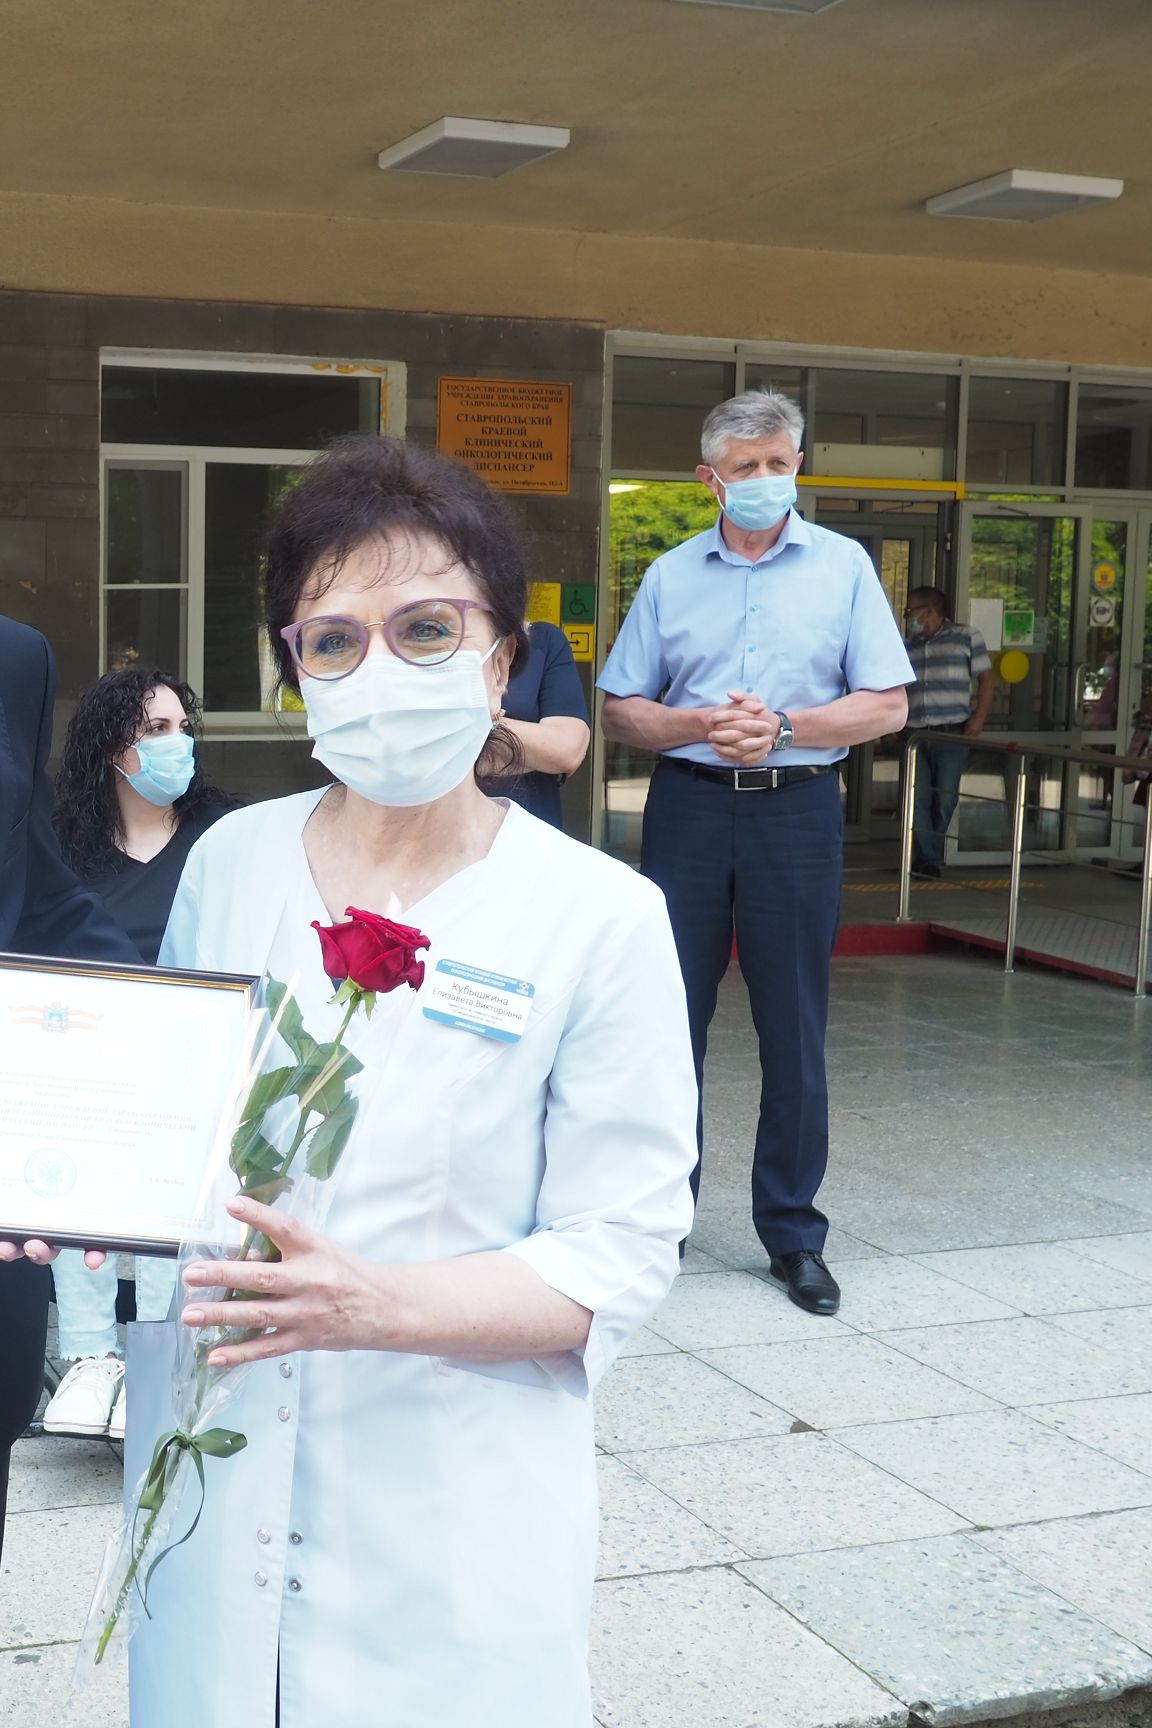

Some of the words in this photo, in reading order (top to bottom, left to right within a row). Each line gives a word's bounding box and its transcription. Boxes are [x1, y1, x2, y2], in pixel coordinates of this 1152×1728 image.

[460, 400, 531, 409] СТАВРОПОЛЬСКОГО
[456, 413, 552, 426] СТАВРОПОЛЬСКИЙ
[481, 426, 528, 437] КРАЕВОЙ
[464, 437, 543, 449] КЛИНИЧЕСКИЙ
[454, 449, 553, 461] ОНКОЛОГИЧЕСКИЙ
[451, 981, 509, 1006] Кубышкина
[432, 986, 474, 1006] Елизавета
[475, 1000, 523, 1021] Викторовна
